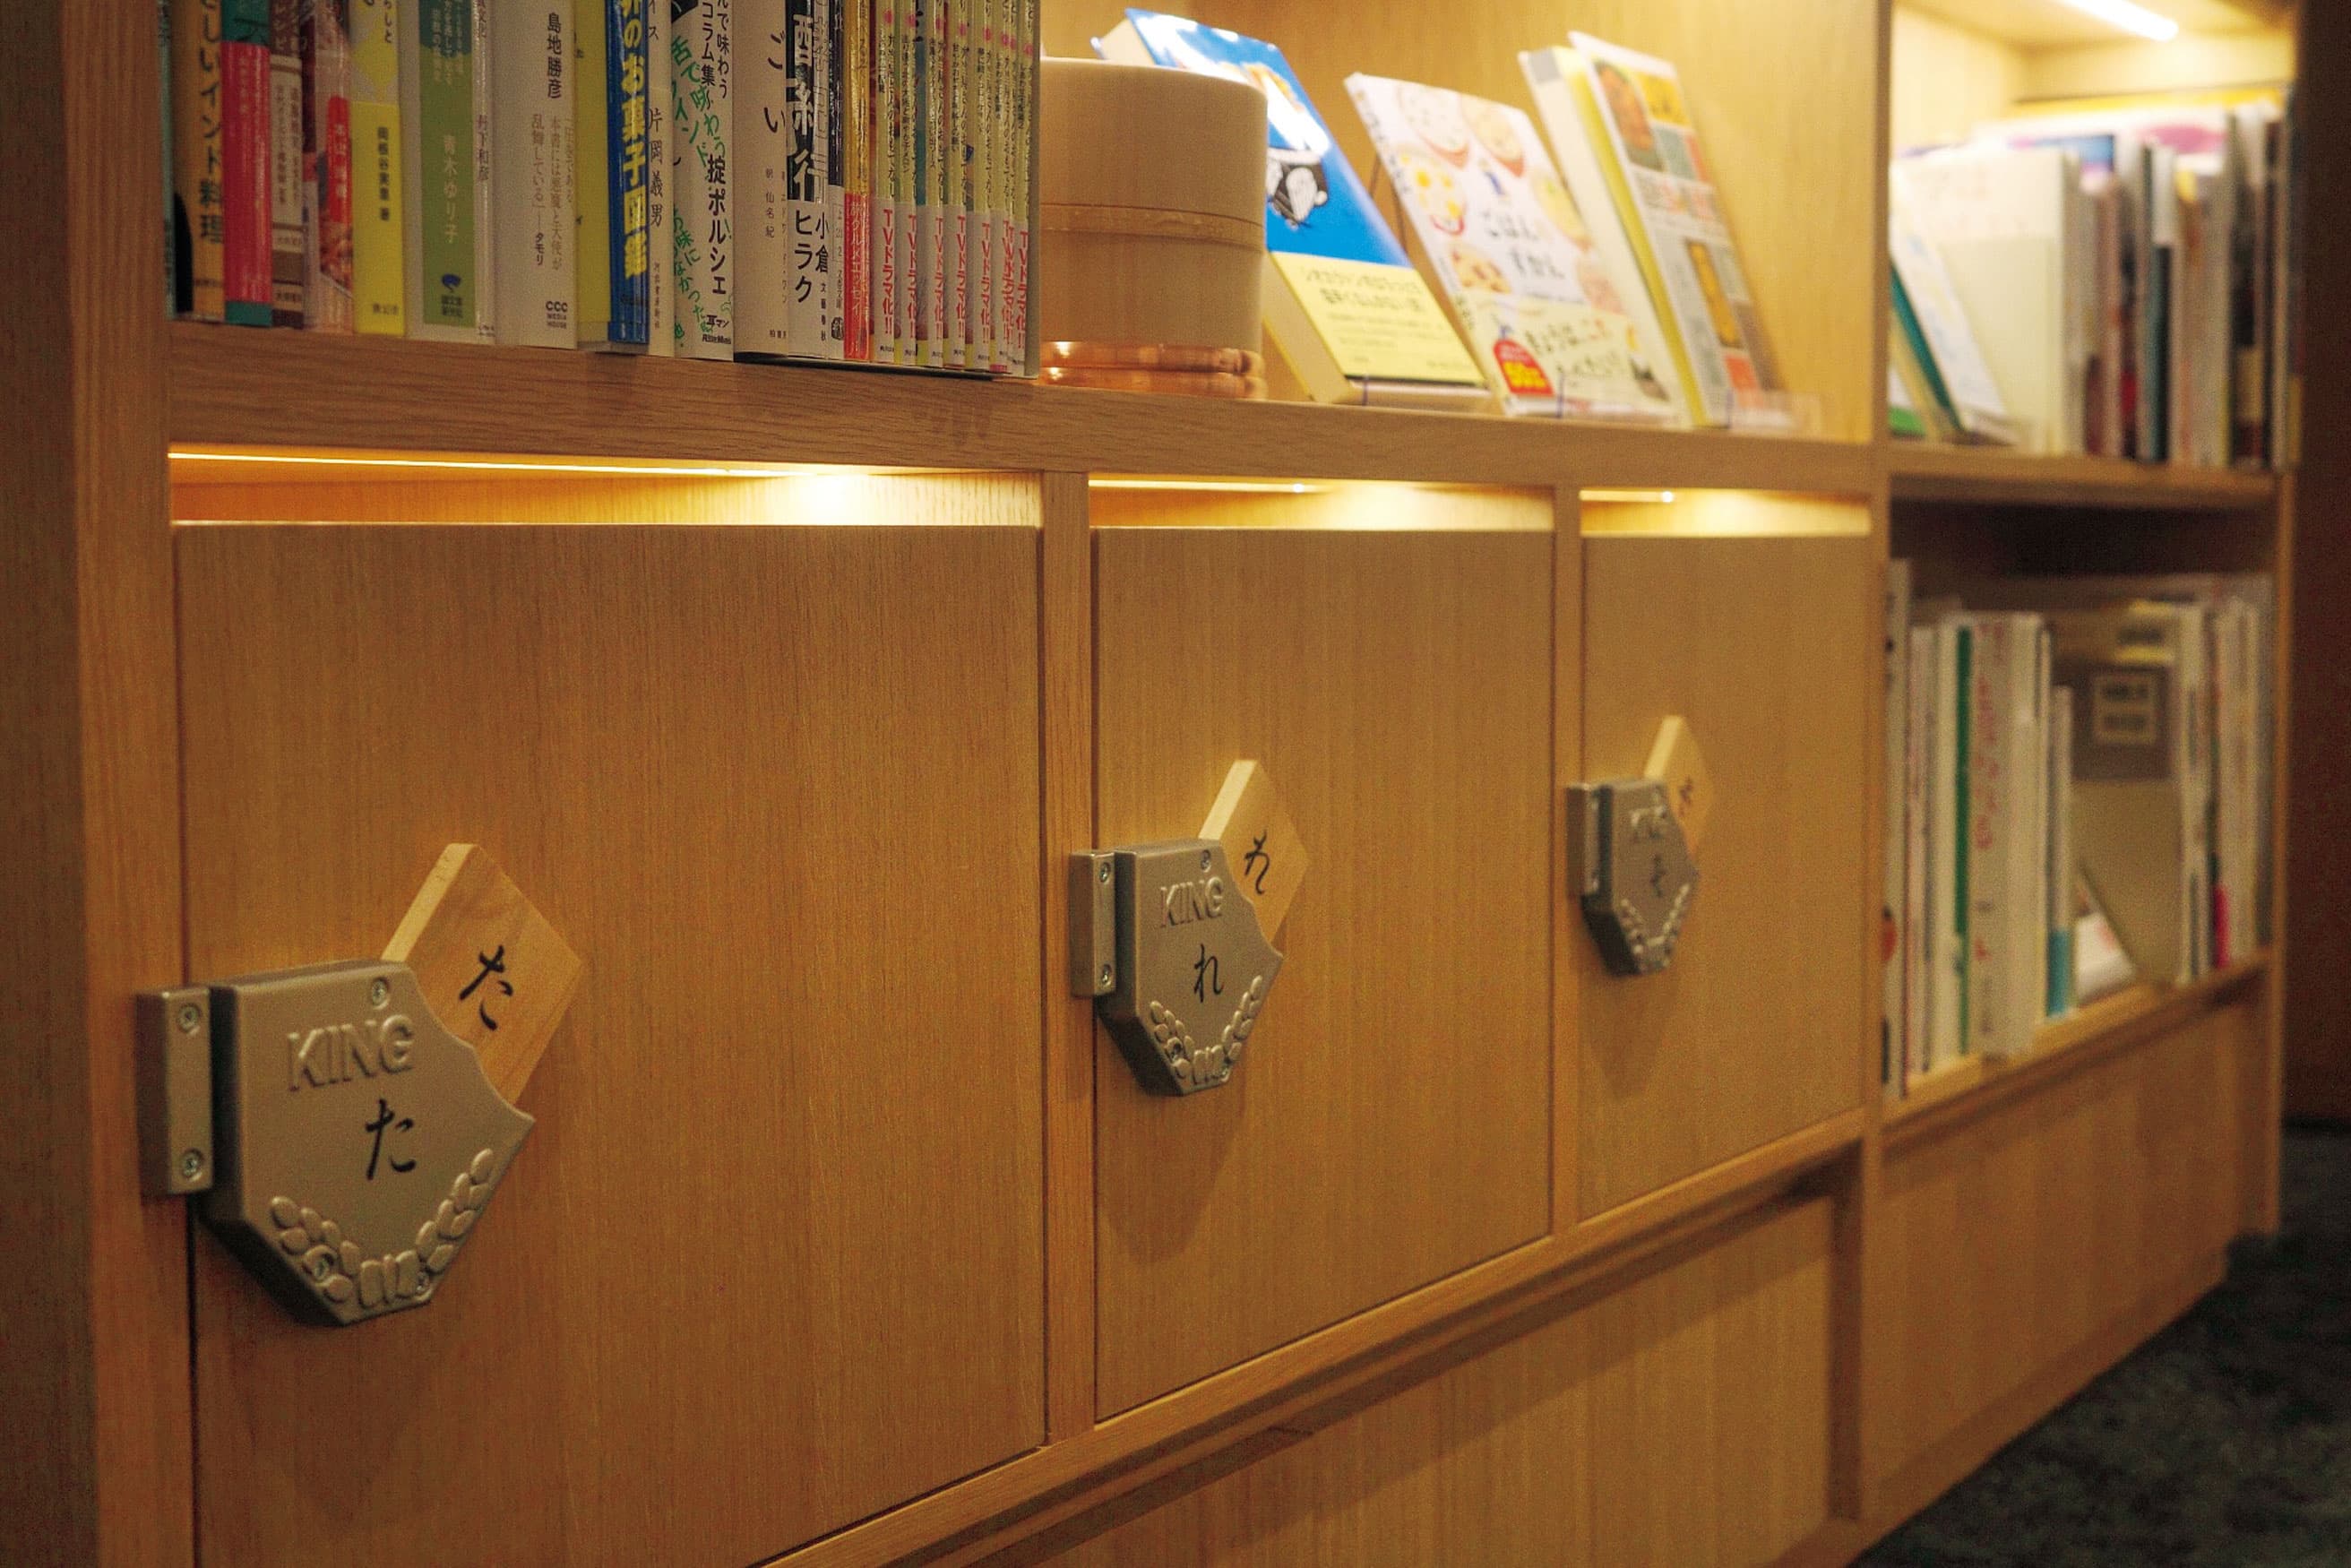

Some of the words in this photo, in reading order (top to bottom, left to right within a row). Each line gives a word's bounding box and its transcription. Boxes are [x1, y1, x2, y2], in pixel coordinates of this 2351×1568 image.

[547, 12, 562, 99] 島地勝彦
[648, 108, 663, 228] 片岡義男
[708, 154, 727, 294] 掟ポルシェ
[794, 209, 813, 303] ヒラク
[814, 211, 829, 273] 小倉
[545, 301, 568, 313] CCC
[1243, 826, 1270, 895] れ
[1158, 875, 1225, 929] KING
[458, 943, 515, 1031] た
[1193, 943, 1225, 1004] れ
[286, 1012, 415, 1093] KING
[364, 1098, 417, 1181] た
